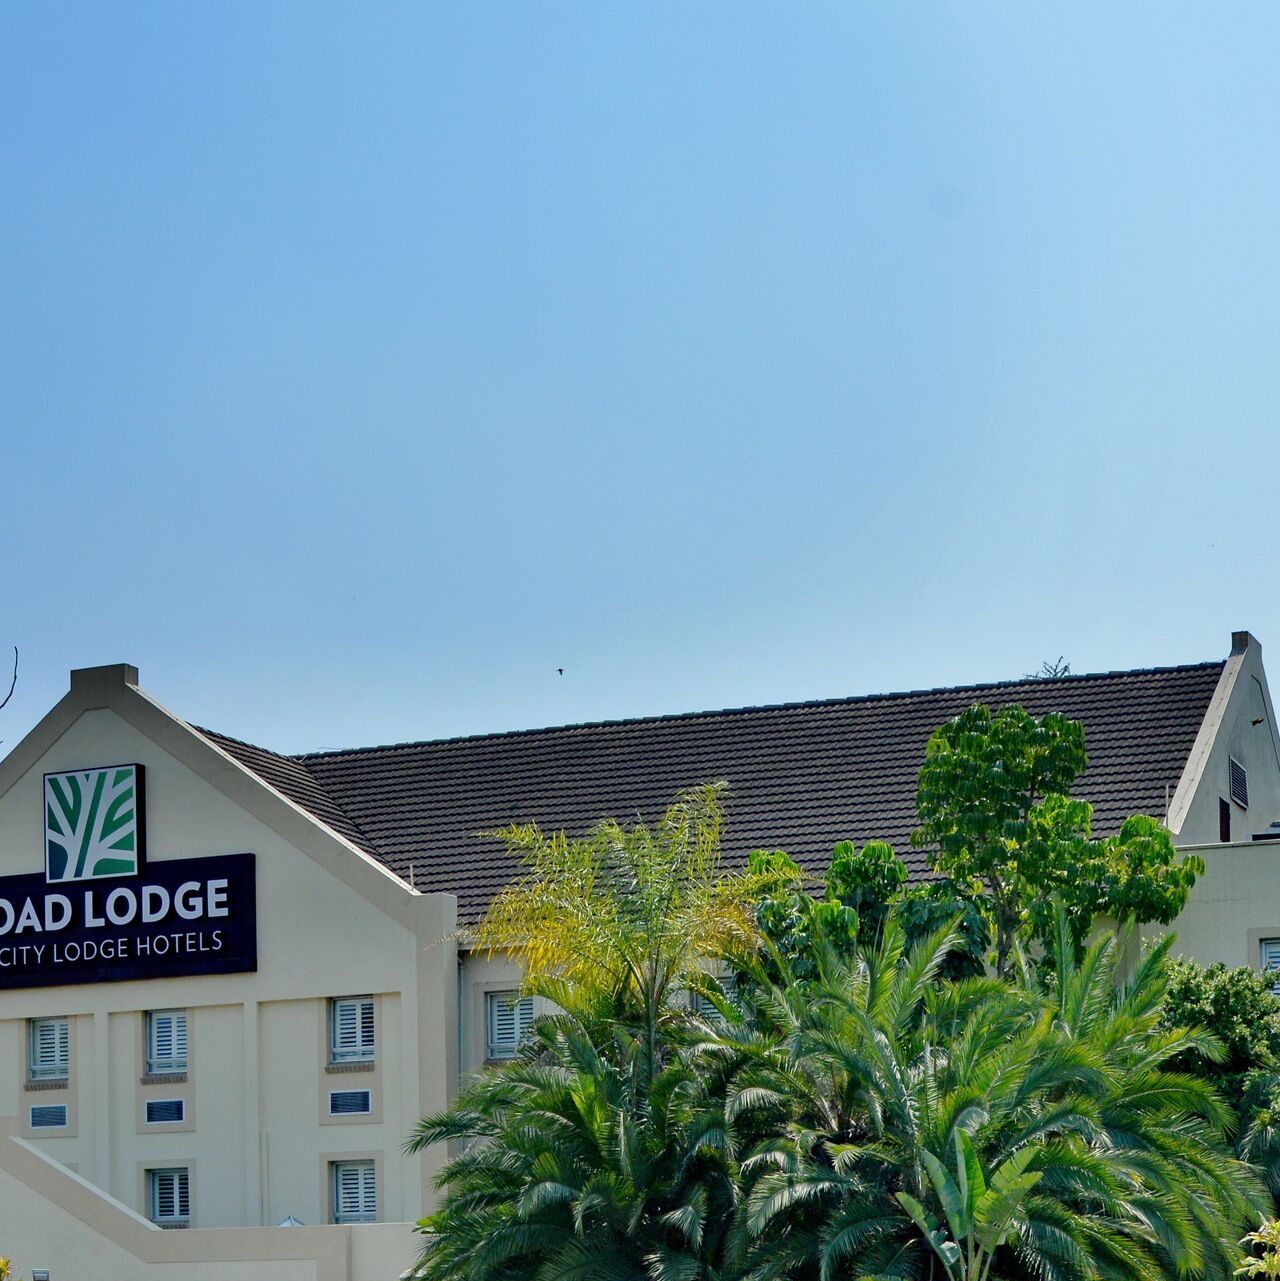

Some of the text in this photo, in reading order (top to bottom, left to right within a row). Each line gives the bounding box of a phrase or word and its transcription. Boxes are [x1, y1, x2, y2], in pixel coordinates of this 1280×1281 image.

[85, 878, 229, 928] LODGE
[53, 938, 128, 963] LODGE
[137, 930, 223, 956] HOTELS
